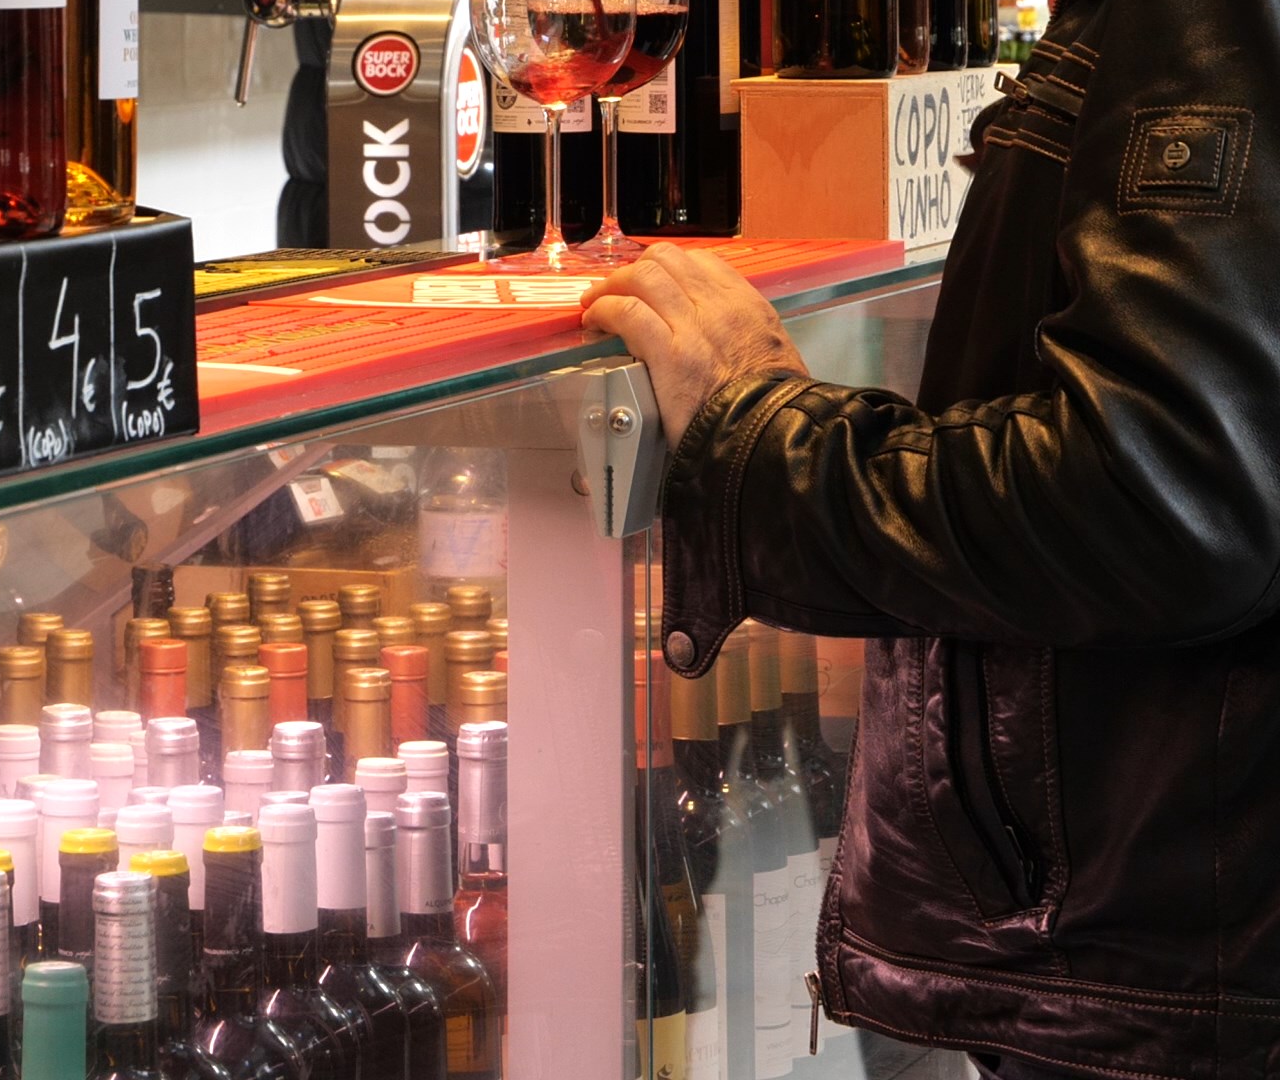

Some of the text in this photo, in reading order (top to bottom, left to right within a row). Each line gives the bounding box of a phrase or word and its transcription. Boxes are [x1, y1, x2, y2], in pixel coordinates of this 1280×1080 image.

[364, 50, 410, 65] SUPER
[365, 63, 408, 79] BOCK
[456, 107, 479, 136] OCK
[894, 86, 951, 170] COPO
[362, 116, 412, 246] OCK
[896, 170, 952, 239] VINHO
